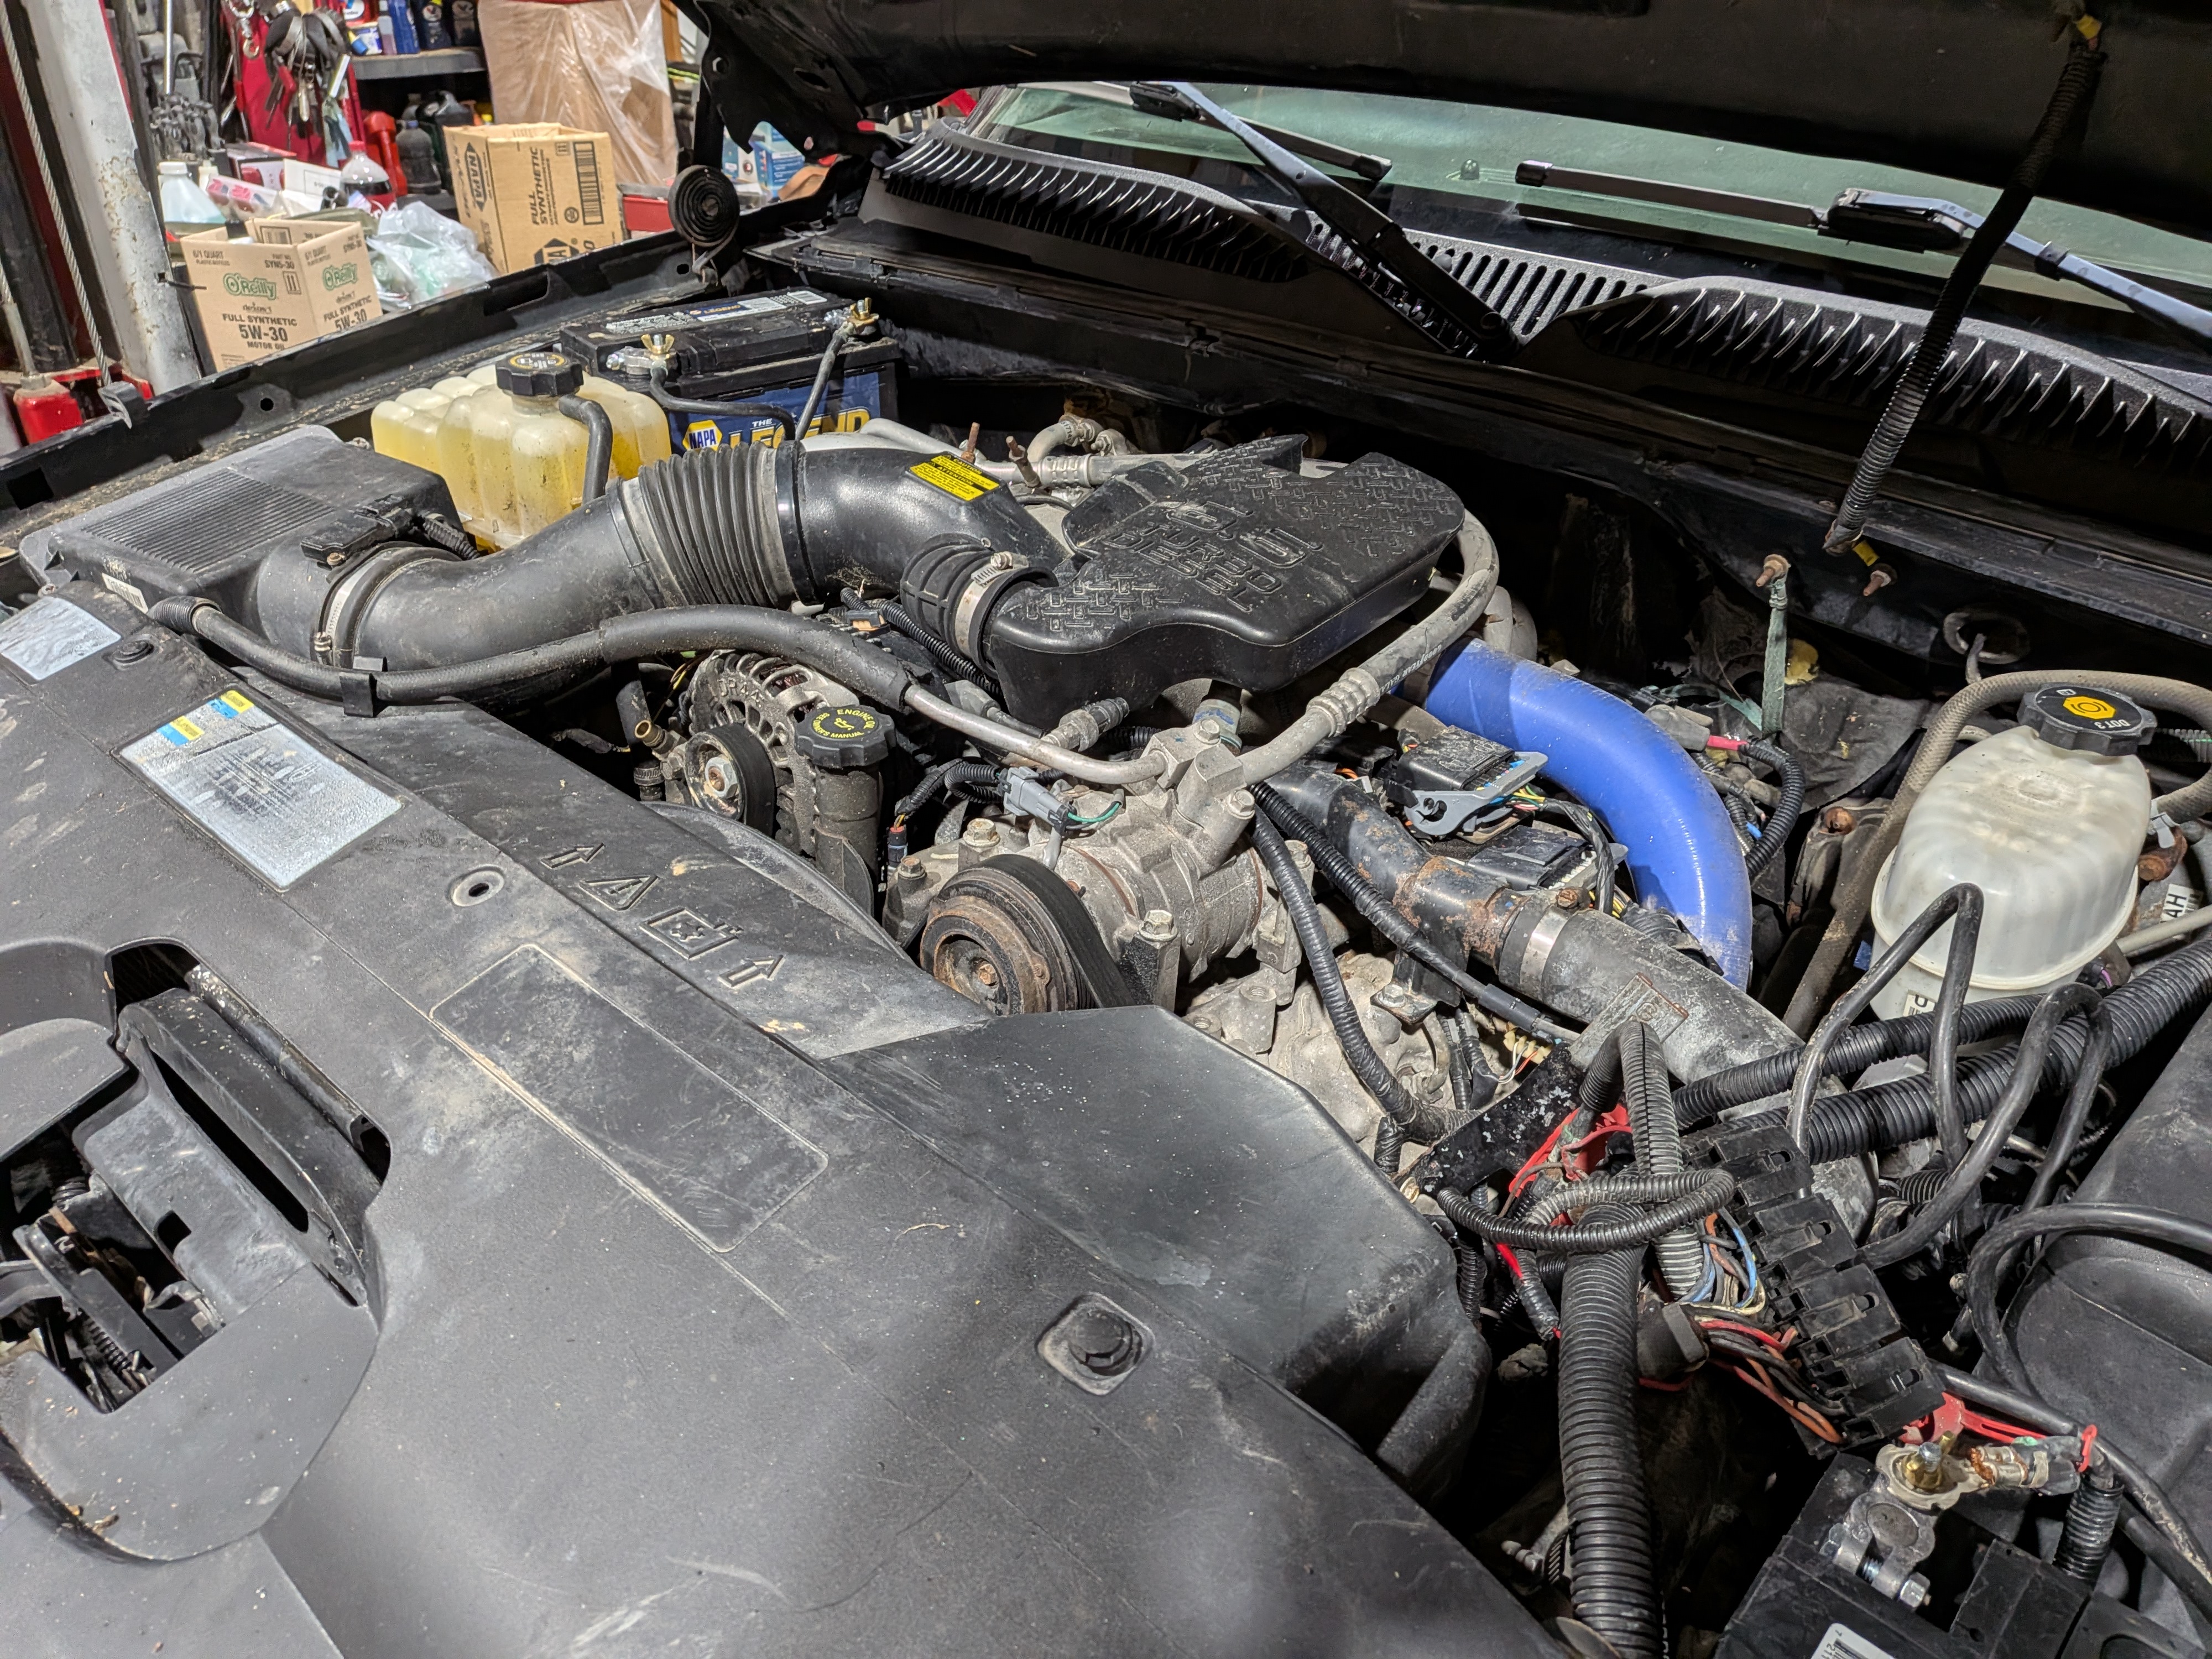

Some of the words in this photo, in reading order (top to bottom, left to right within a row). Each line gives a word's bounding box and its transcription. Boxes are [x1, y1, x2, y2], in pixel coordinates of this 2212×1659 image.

[467, 153, 483, 200] NAPA
[530, 147, 548, 225] SYNTHETIC
[529, 191, 540, 226] FULL
[223, 273, 276, 300] O'Reilly
[324, 310, 339, 322] FULL
[340, 295, 372, 315] SYNTHETIC
[222, 313, 245, 322] FULL
[247, 315, 298, 327] SYNTHETIC
[335, 308, 367, 331] 5W-30
[238, 324, 289, 342] 5W-30
[247, 341, 273, 349] MOTOR
[752, 418, 773, 427] THE
[689, 429, 717, 450] NAPA
[937, 466, 974, 486] ATTENTION
[953, 458, 983, 475] CAUTION
[1138, 523, 1283, 594] TURBO
[1103, 532, 1253, 612] DIESEL
[1402, 644, 1442, 678] GOODYEAR
[816, 712, 830, 721] SEE
[837, 709, 874, 721] ENGINE
[863, 721, 875, 729] OIL
[2094, 721, 2106, 729] 3
[2105, 719, 2131, 729] DOT
